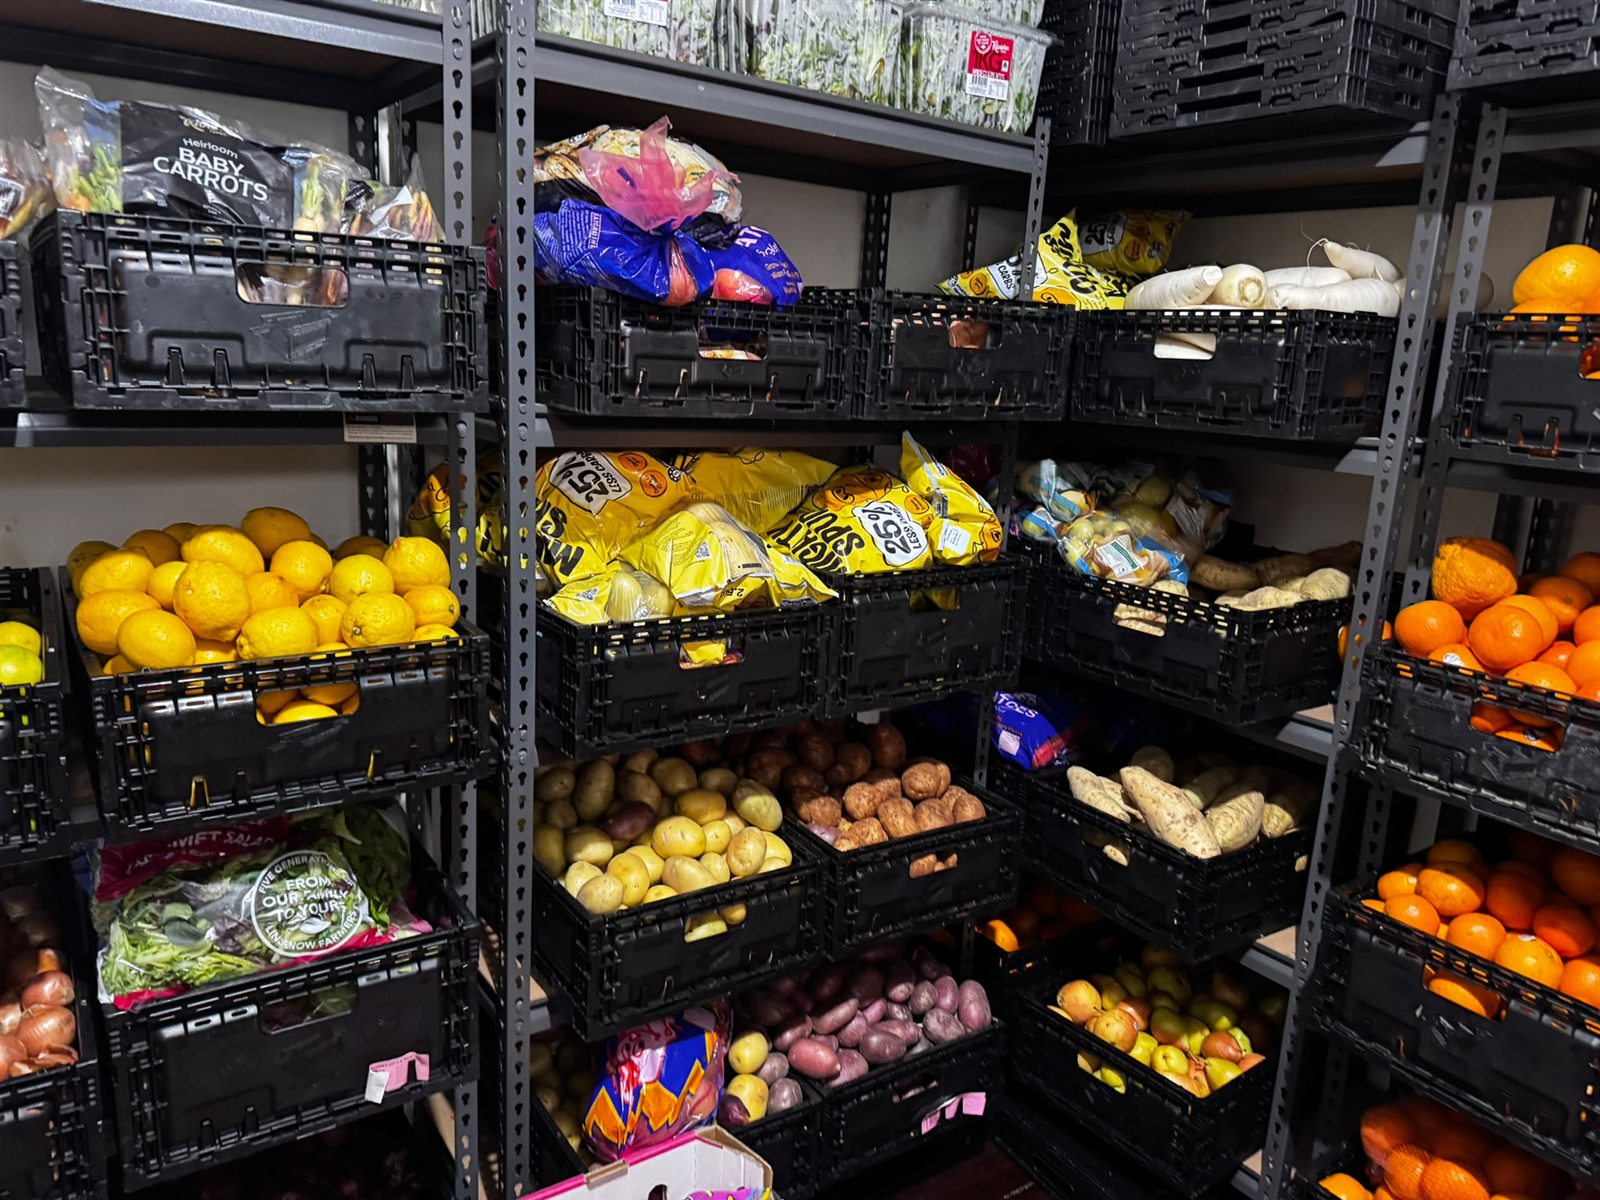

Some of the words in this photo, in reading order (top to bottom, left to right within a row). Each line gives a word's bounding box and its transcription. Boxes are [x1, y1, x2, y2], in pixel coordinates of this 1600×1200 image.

[182, 138, 238, 159] Heirloom
[179, 147, 244, 177] BABY
[153, 156, 268, 201] CARROTS
[997, 265, 1016, 290] CARBS
[556, 457, 610, 503] 25%
[602, 472, 622, 493] LESS
[861, 507, 911, 554] 25%
[903, 525, 922, 549] LESS
[258, 871, 275, 894] FIVE
[286, 876, 332, 891] FROM
[262, 892, 298, 908] OUR
[304, 888, 349, 901] FAMILY
[276, 907, 295, 922] TO
[265, 924, 316, 950] LINDENOW
[319, 910, 357, 947] FARMERS
